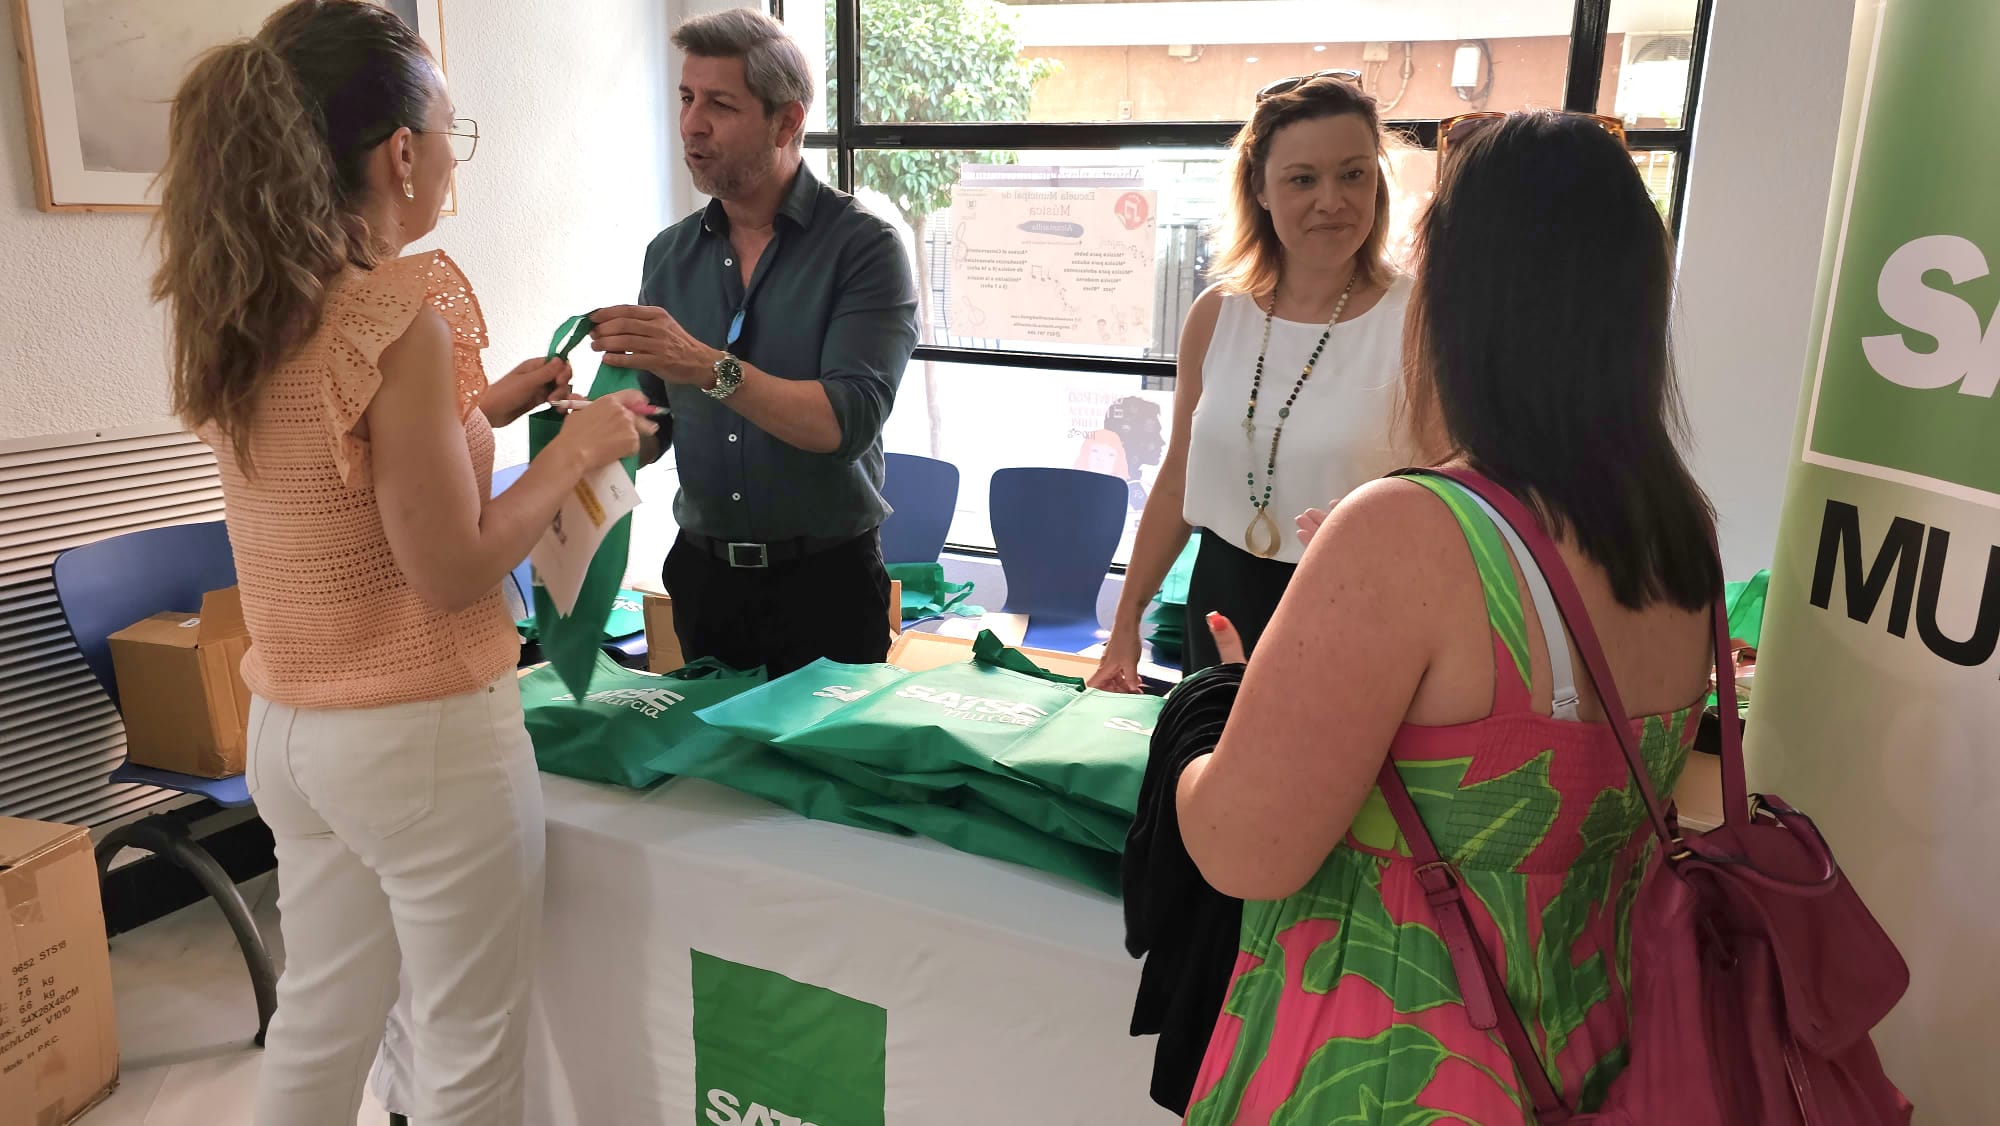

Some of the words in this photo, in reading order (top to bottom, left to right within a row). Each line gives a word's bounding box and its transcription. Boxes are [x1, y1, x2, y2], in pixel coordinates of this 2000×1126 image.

[1810, 499, 2000, 681] MU
[896, 685, 1048, 723] SATSE
[12, 957, 35, 976] 9652
[18, 975, 29, 987] 25
[42, 976, 54, 988] kg
[43, 989, 55, 1001] kg
[0, 1024, 41, 1056] tch/Lote:
[706, 1088, 820, 1126] SAT
